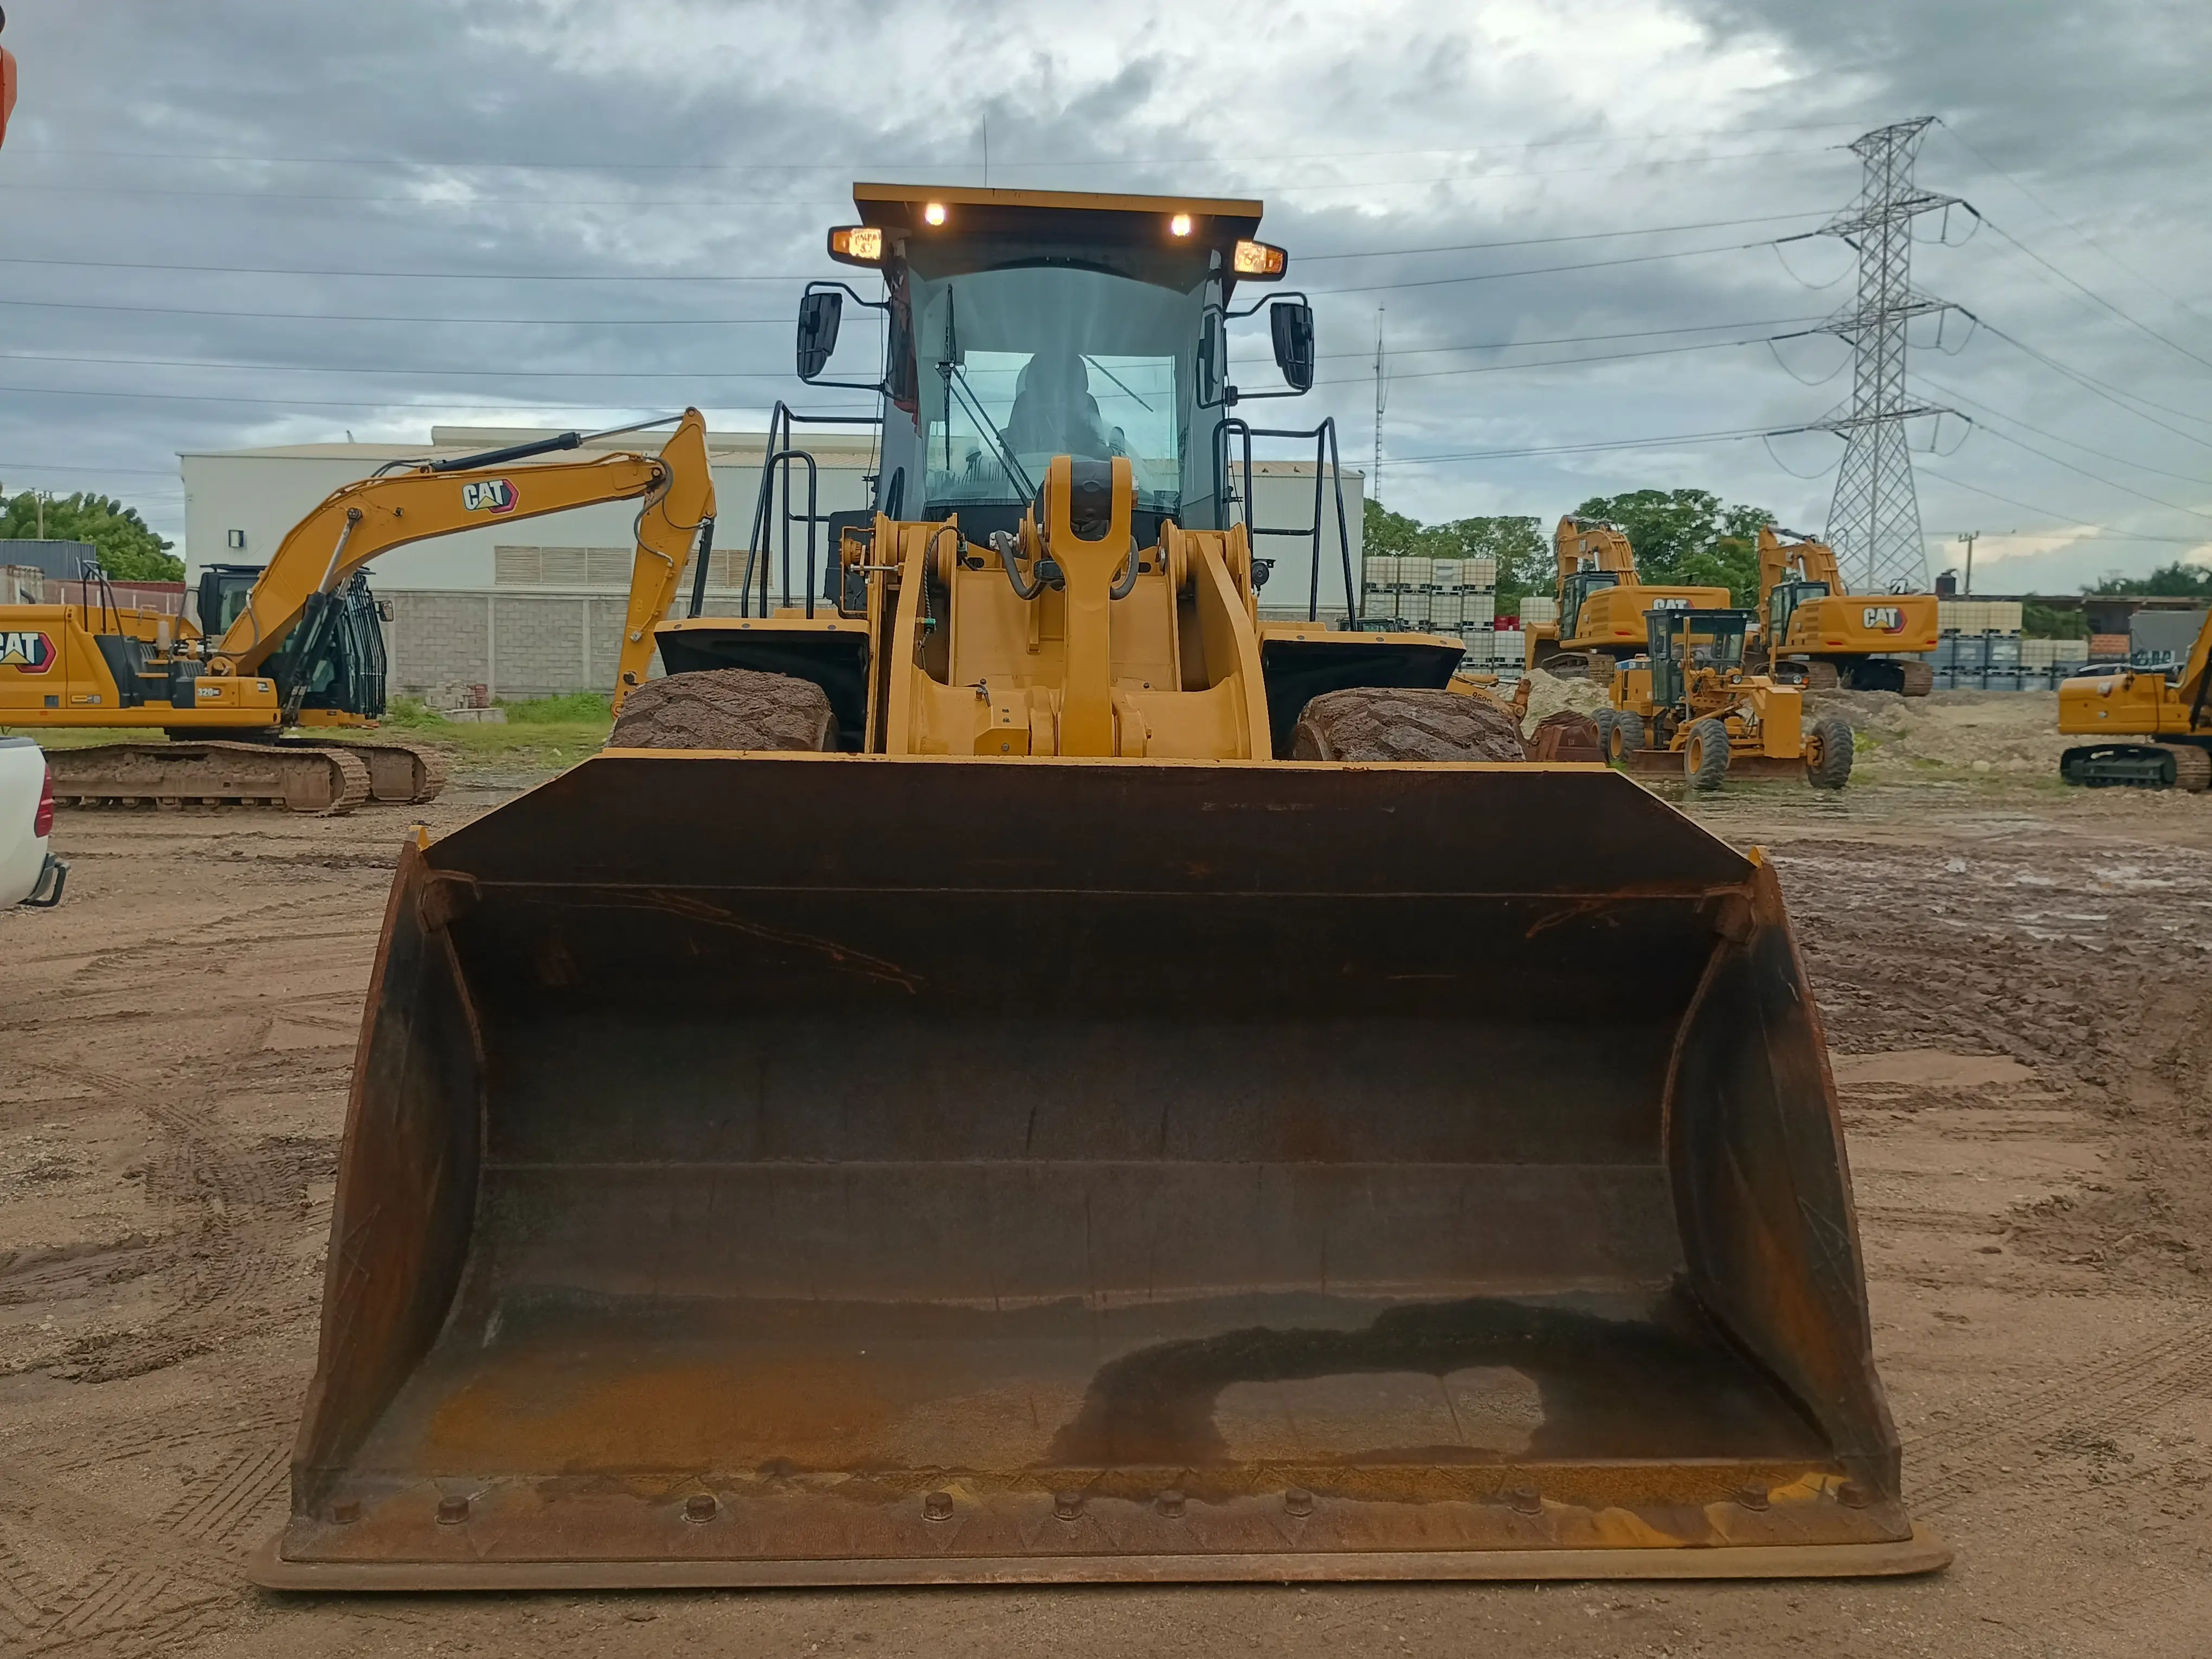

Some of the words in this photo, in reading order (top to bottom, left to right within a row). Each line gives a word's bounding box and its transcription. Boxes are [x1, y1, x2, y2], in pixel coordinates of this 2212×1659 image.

[463, 480, 503, 510] CAT
[1863, 608, 1898, 628] CAT
[0, 633, 38, 664] AT
